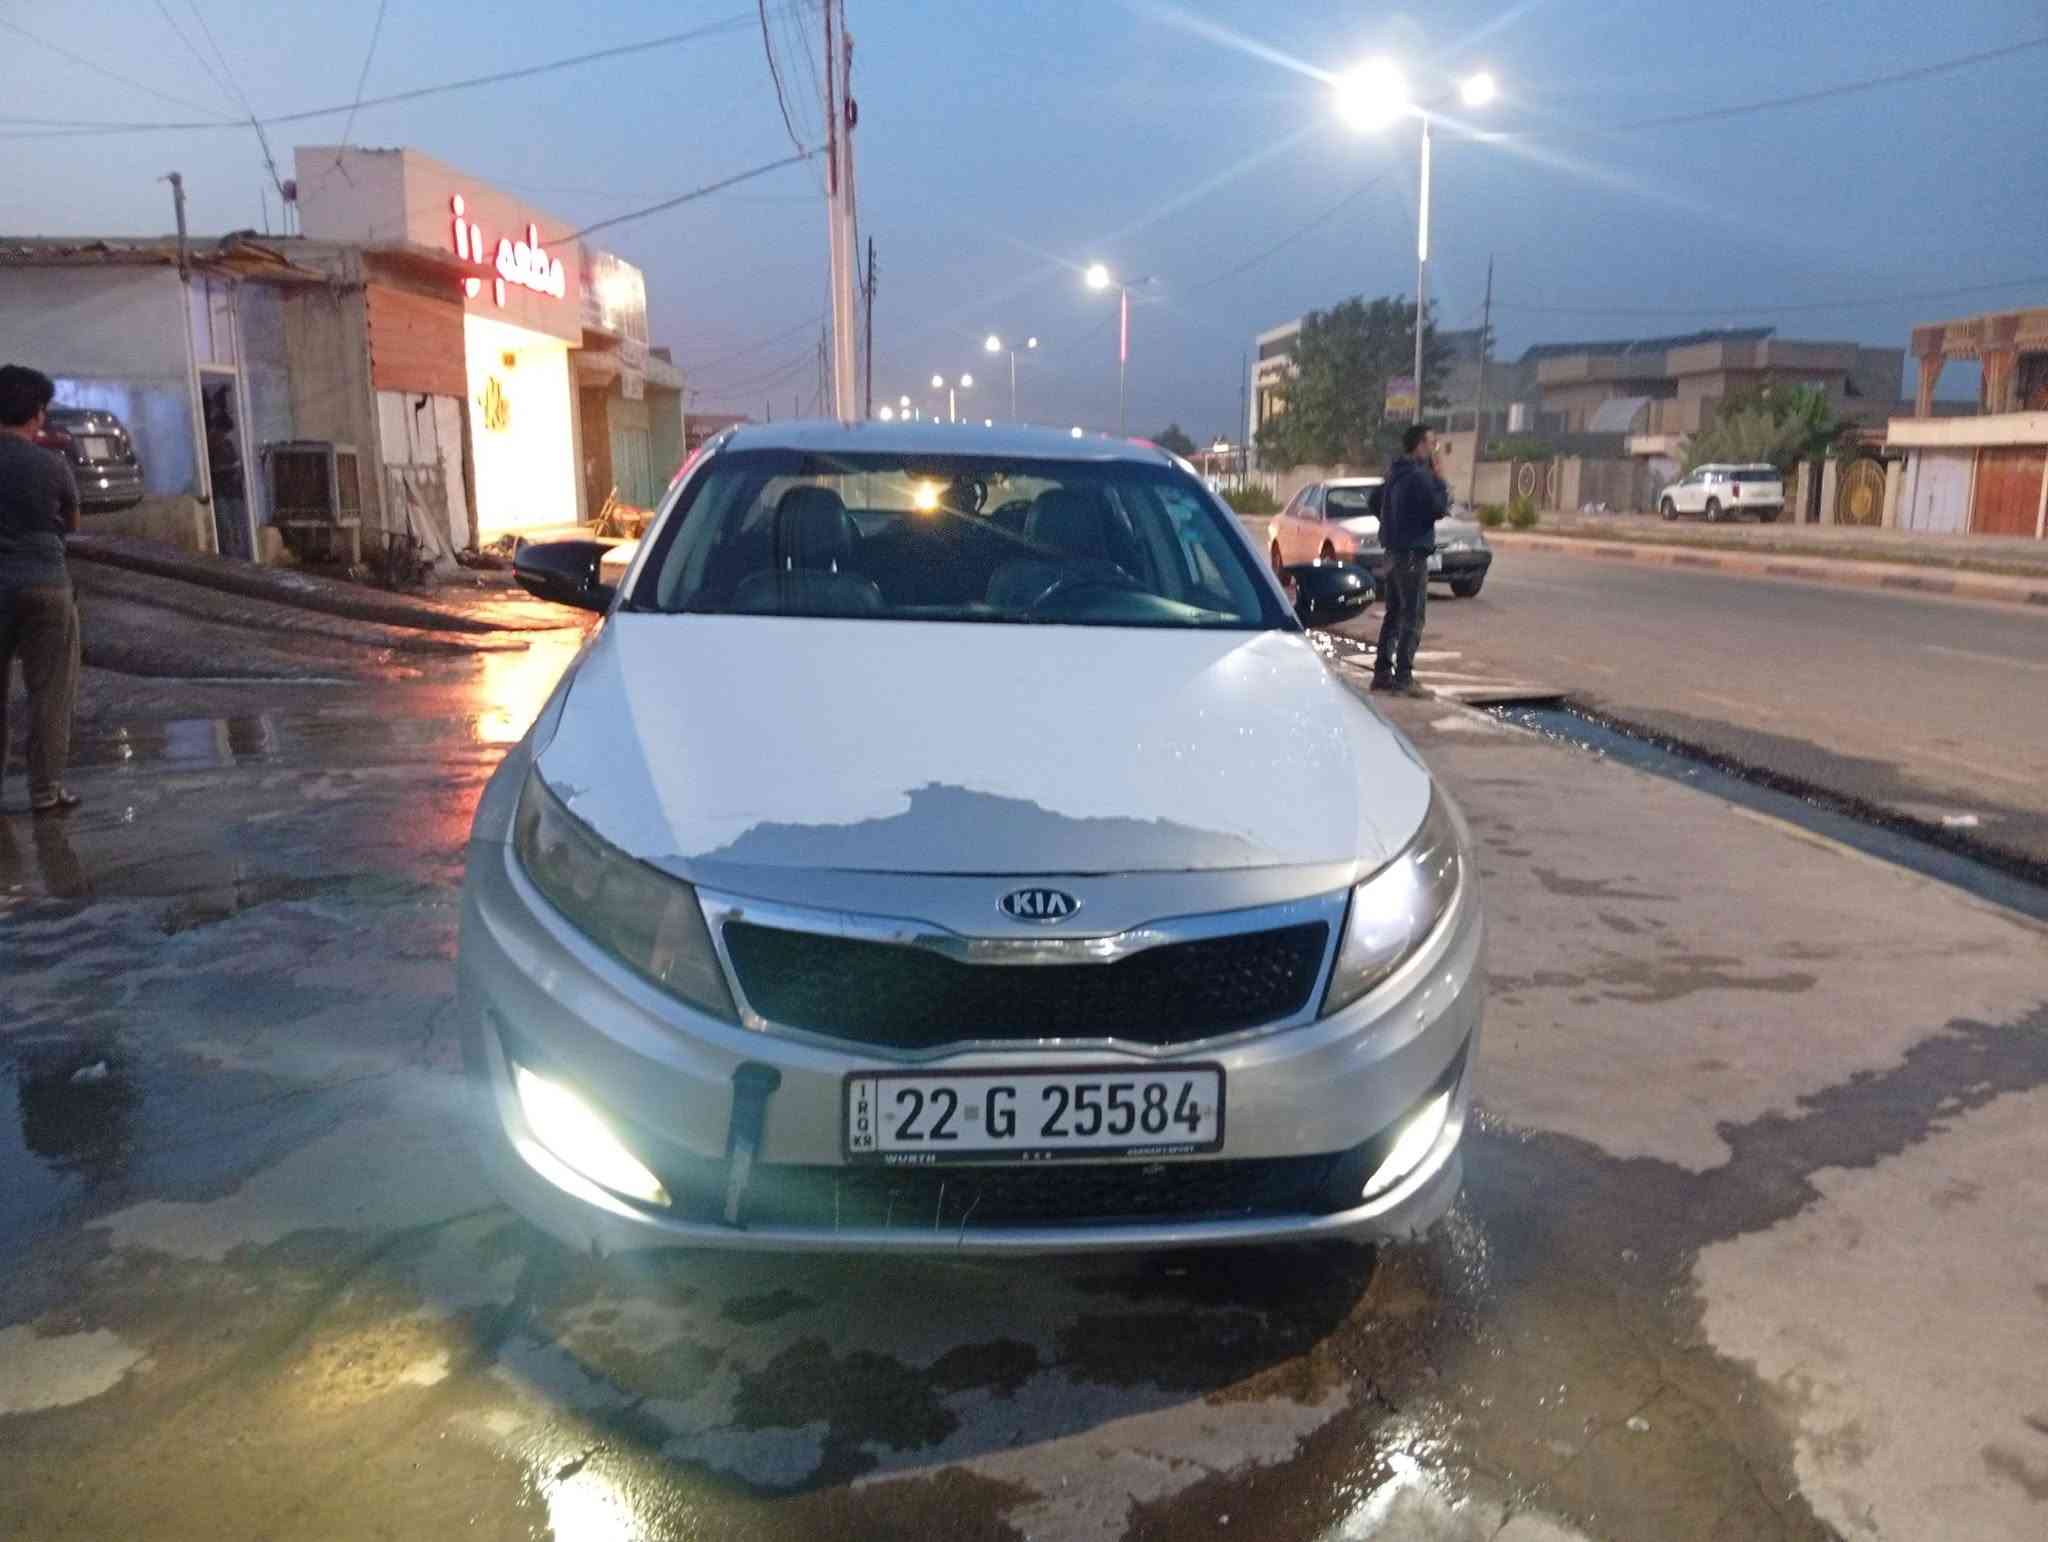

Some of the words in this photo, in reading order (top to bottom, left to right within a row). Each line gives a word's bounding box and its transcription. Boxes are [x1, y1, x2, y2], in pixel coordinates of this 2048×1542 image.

[496, 223, 566, 308] مطعم
[1013, 892, 1068, 914] KIA
[895, 1088, 959, 1141] 22
[985, 1086, 1017, 1138] G
[1040, 1082, 1201, 1137] 25584
